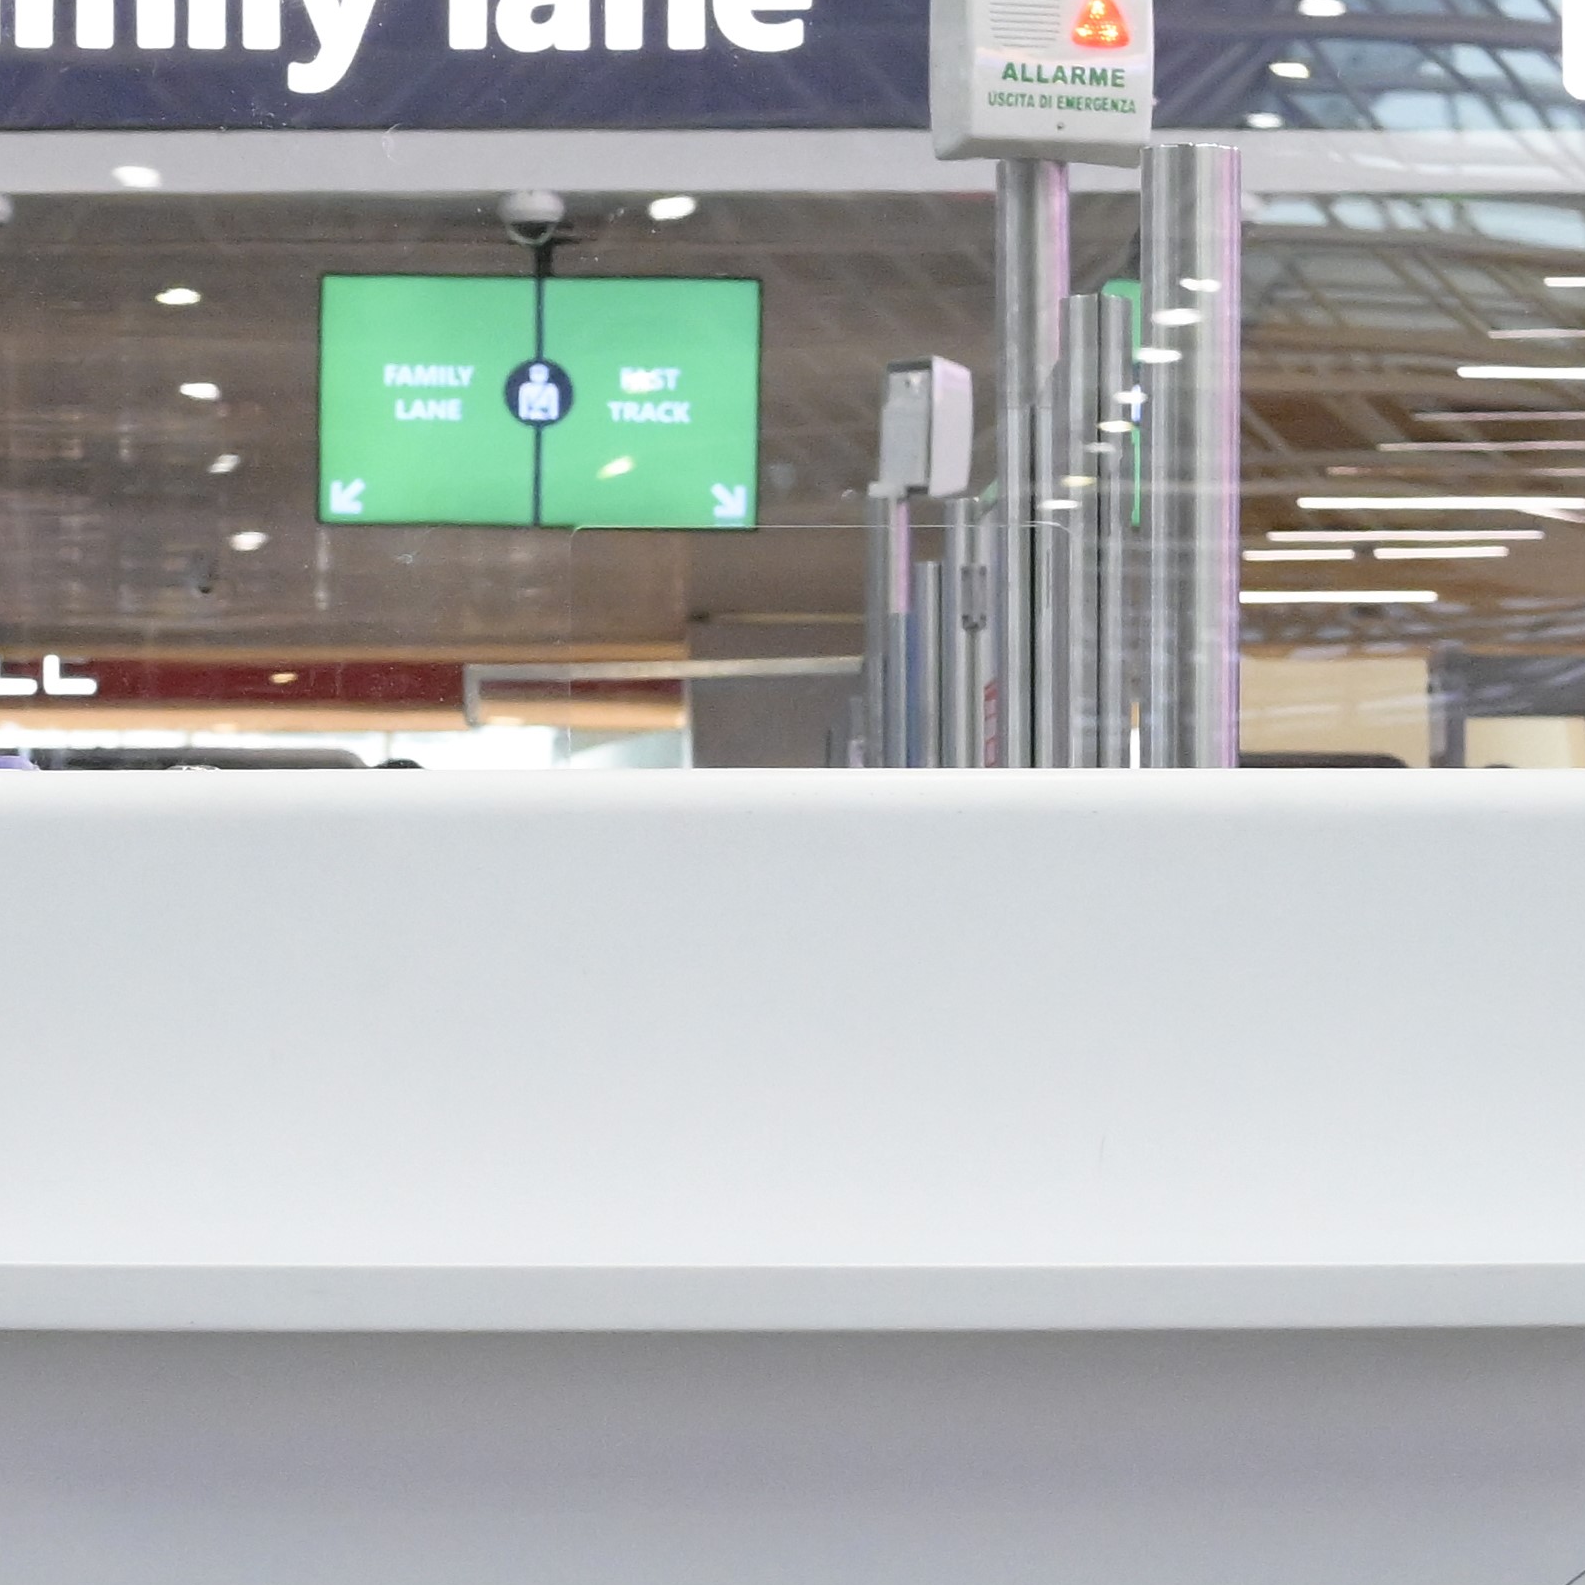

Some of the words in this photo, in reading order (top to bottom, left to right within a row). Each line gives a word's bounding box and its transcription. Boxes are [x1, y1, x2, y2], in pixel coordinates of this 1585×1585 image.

[1001, 61, 1126, 89] ALLARME
[987, 90, 1036, 109] USCITA
[1038, 94, 1053, 109] DI
[1056, 95, 1137, 114] EMERGENZA
[383, 363, 475, 388] FAMILY
[394, 398, 463, 421] LANE
[607, 400, 691, 424] TRACK
